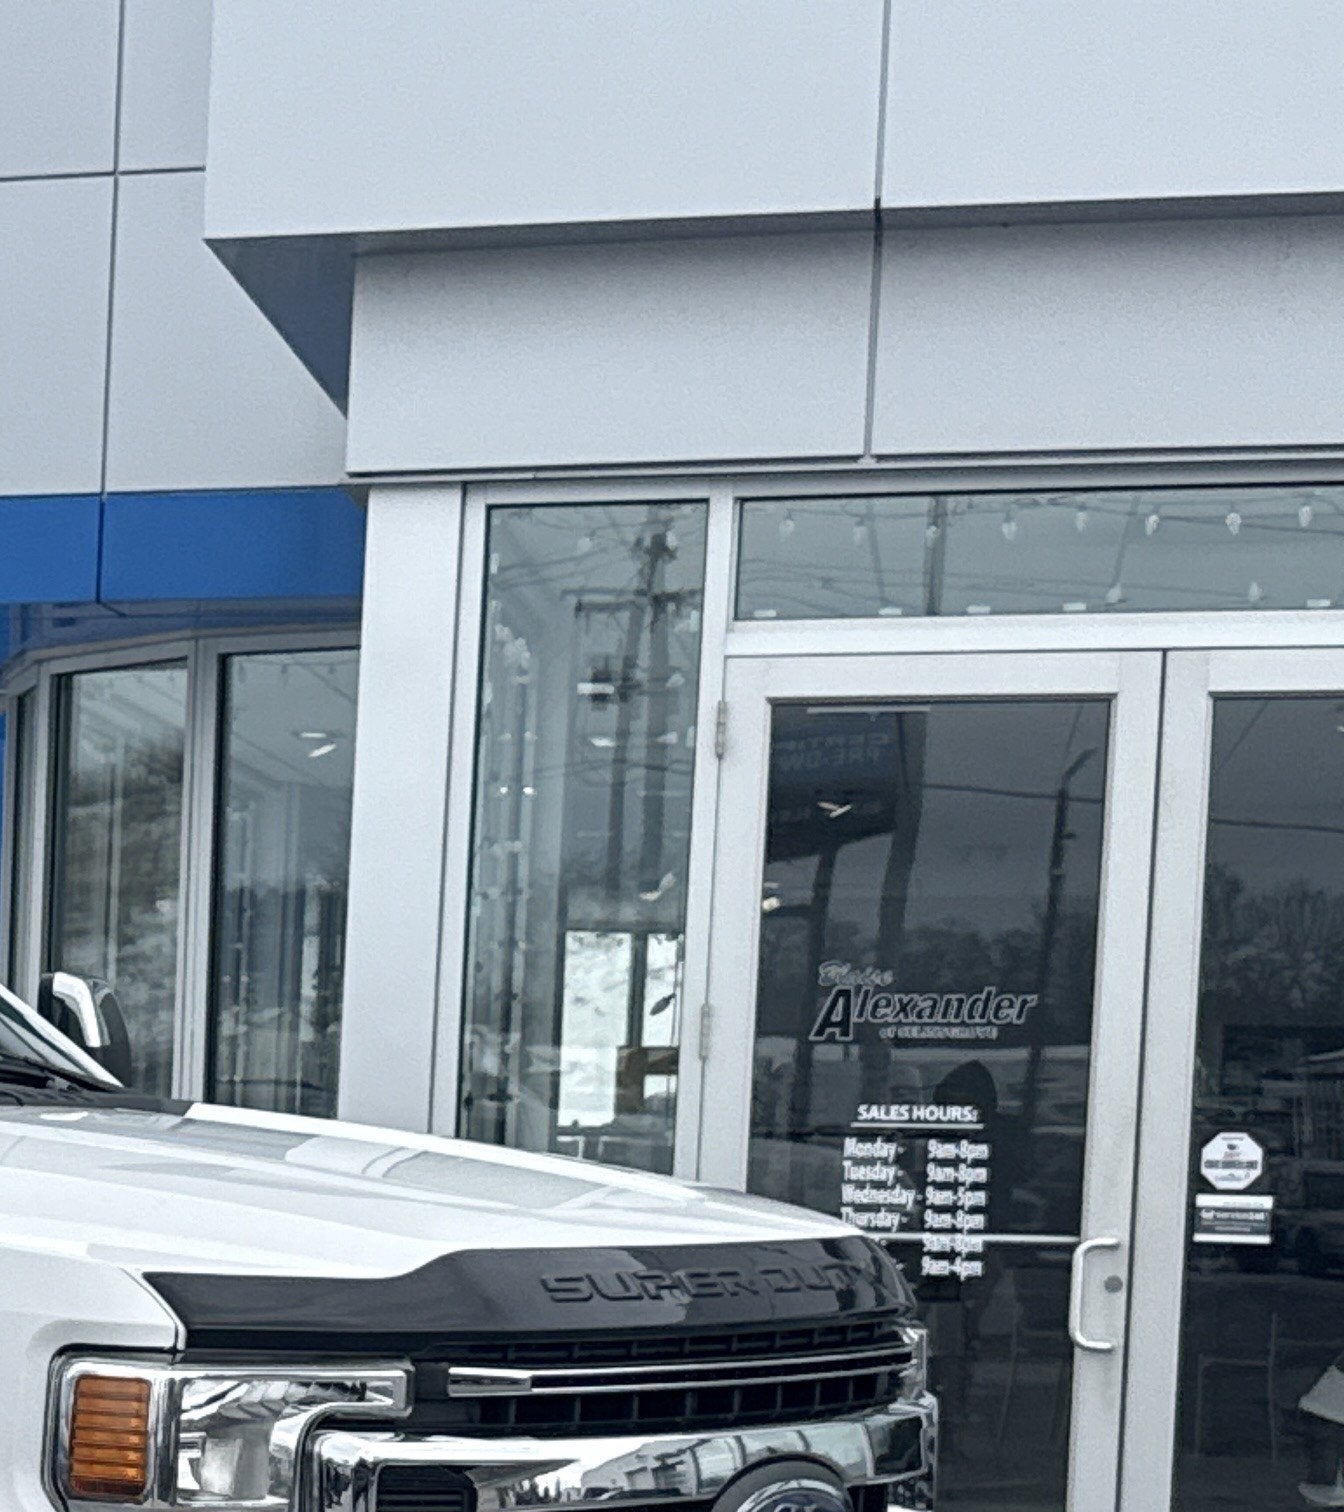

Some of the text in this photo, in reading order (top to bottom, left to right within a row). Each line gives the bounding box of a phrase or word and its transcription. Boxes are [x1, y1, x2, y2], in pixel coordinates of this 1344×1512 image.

[809, 985, 1039, 1041] Alexander
[857, 1104, 979, 1123] SALES HOURS:
[540, 1267, 759, 1303] SUPER
